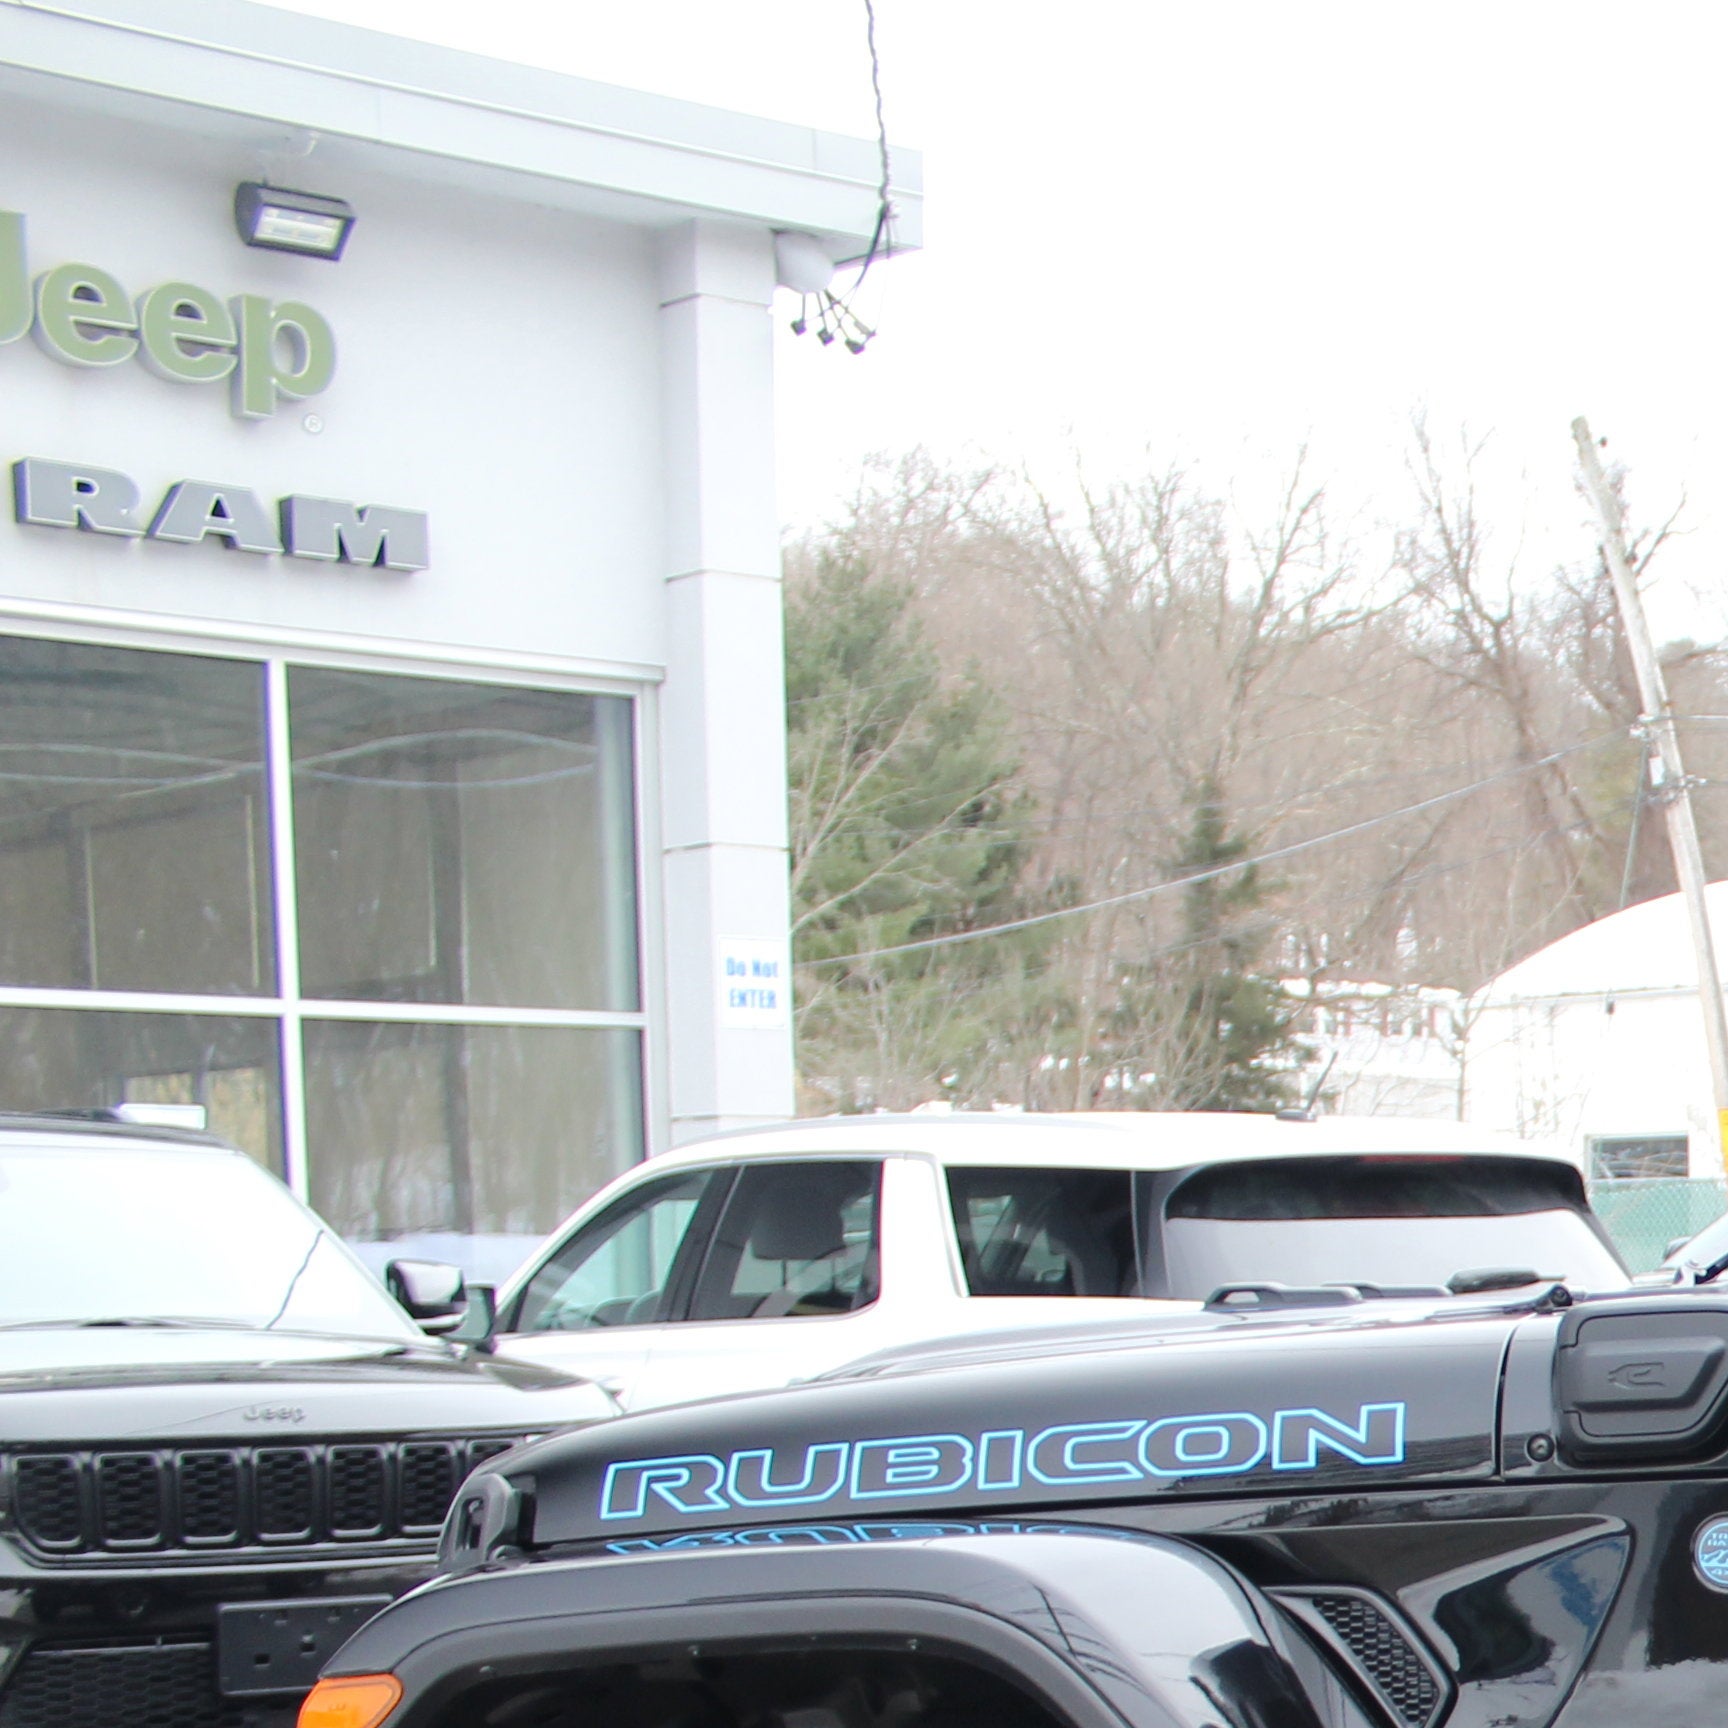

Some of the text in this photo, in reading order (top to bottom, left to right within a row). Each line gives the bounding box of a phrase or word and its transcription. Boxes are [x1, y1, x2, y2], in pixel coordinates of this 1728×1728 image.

[13, 456, 430, 571] RAM
[725, 956, 779, 978] Do Not
[728, 987, 778, 1009] ENTER
[241, 1404, 307, 1424] Jeep
[600, 1401, 1405, 1521] RUBICON
